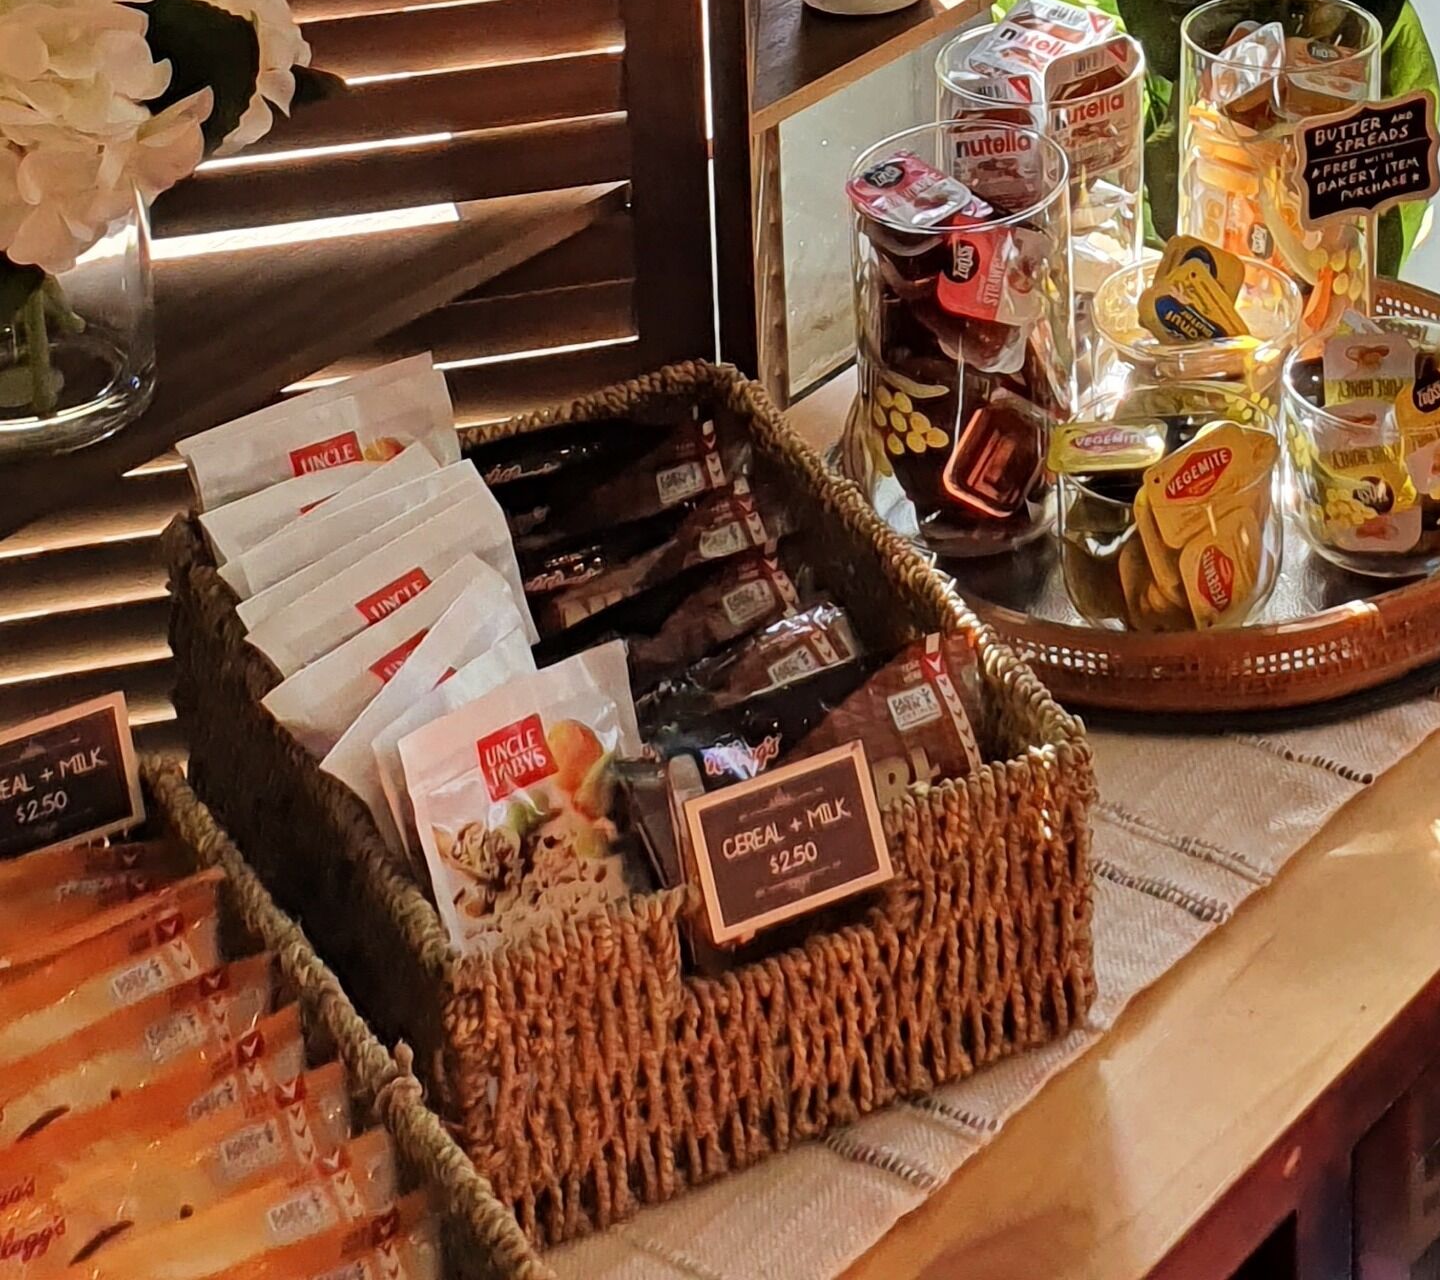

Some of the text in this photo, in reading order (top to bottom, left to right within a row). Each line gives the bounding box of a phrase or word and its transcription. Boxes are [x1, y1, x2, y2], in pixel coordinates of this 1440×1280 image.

[1054, 92, 1125, 132] nutella
[1314, 110, 1414, 146] BUTTER AND
[955, 132, 1032, 159] nutella
[1334, 124, 1409, 154] SPREADS
[1316, 156, 1420, 195] BAKERY ITEM
[1322, 157, 1358, 177] FREE
[1340, 173, 1408, 203] PURCHASE
[1164, 310, 1199, 340] anut
[301, 444, 355, 475] UNCLE
[1166, 447, 1231, 497] VEGEMITE
[1203, 546, 1230, 610] VEGEMITE
[369, 579, 425, 620] UNCLE
[484, 729, 537, 767] UNCLE
[0, 746, 108, 799] EAL + MILK
[722, 798, 851, 858] CEREAL + MILK
[768, 843, 818, 876] $2.50
[0, 1214, 67, 1265] logg's
